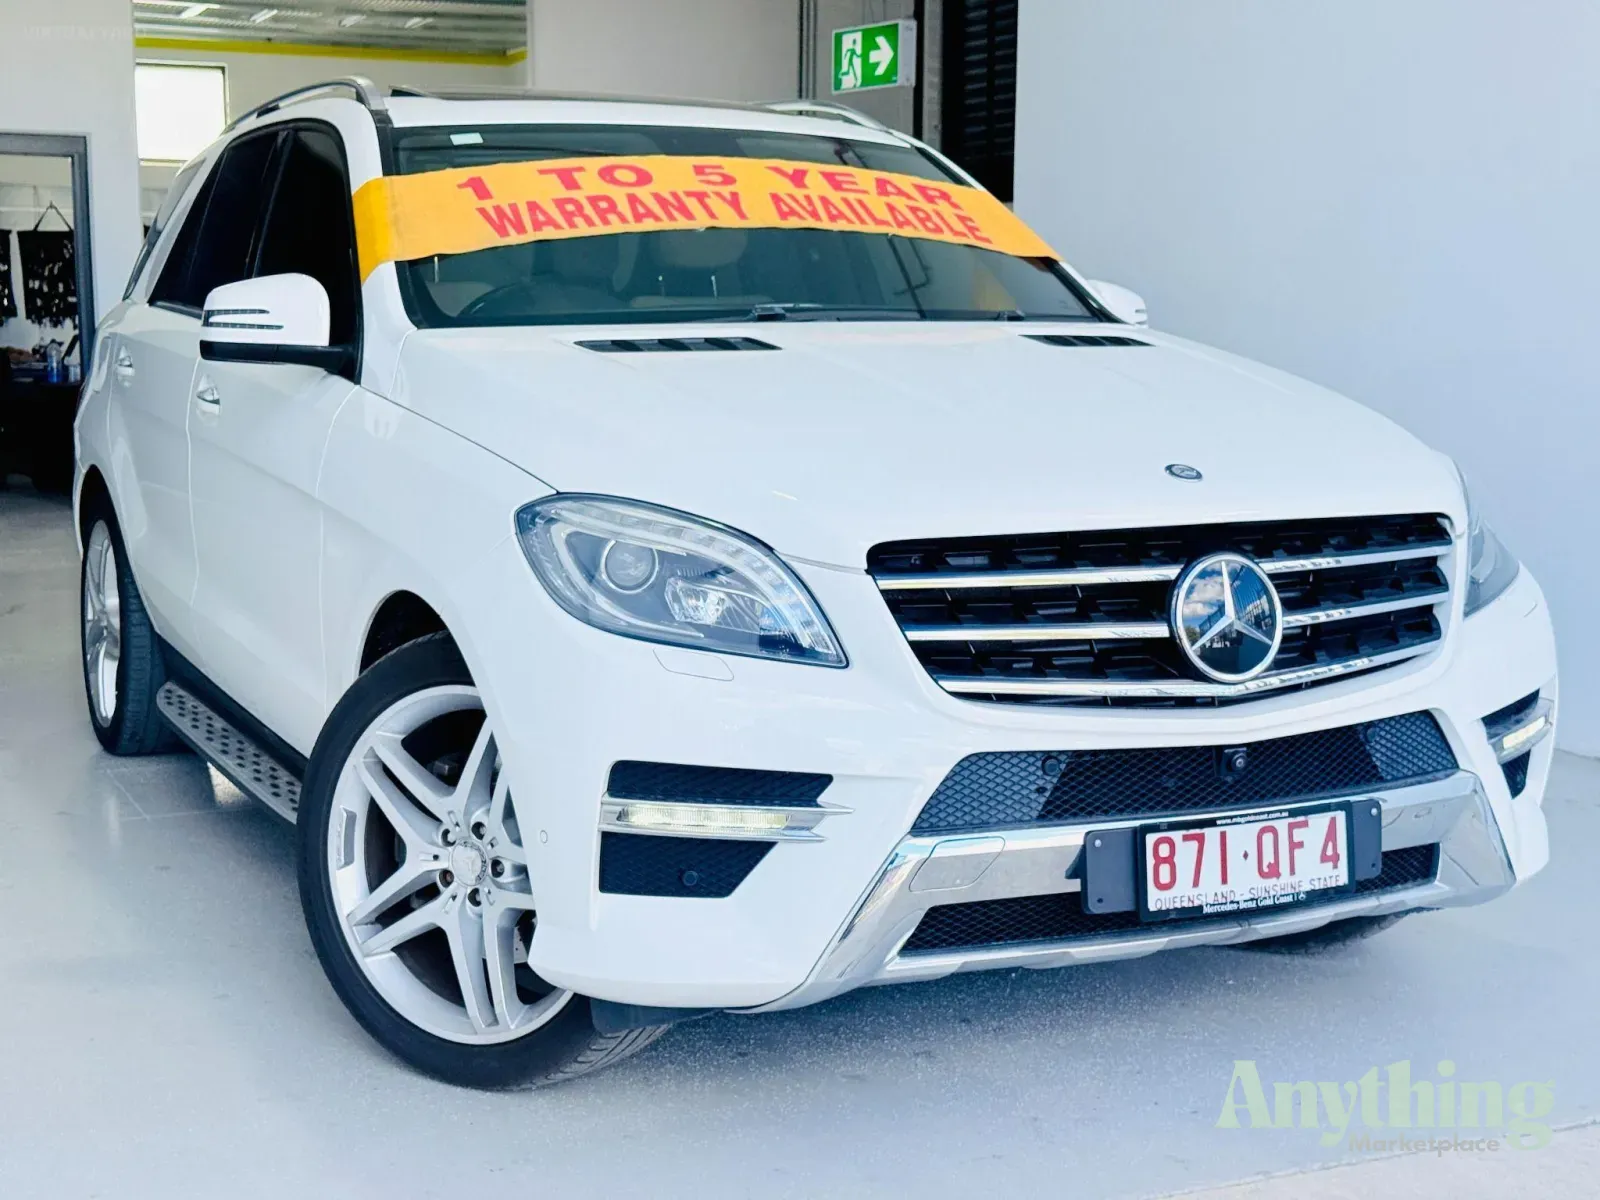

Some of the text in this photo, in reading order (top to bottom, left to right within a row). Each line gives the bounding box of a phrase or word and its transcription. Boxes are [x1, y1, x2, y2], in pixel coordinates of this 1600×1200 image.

[456, 164, 965, 212] 1 TO 5 YEAR
[475, 190, 994, 245] WARRANTY AVAILABLE
[1154, 889, 1237, 911] QUEENSLAND
[1248, 879, 1304, 900] SUNSHINE
[1308, 874, 1341, 892] STATE
[1202, 893, 1294, 915] Mercedes-Benz Gold Coast
